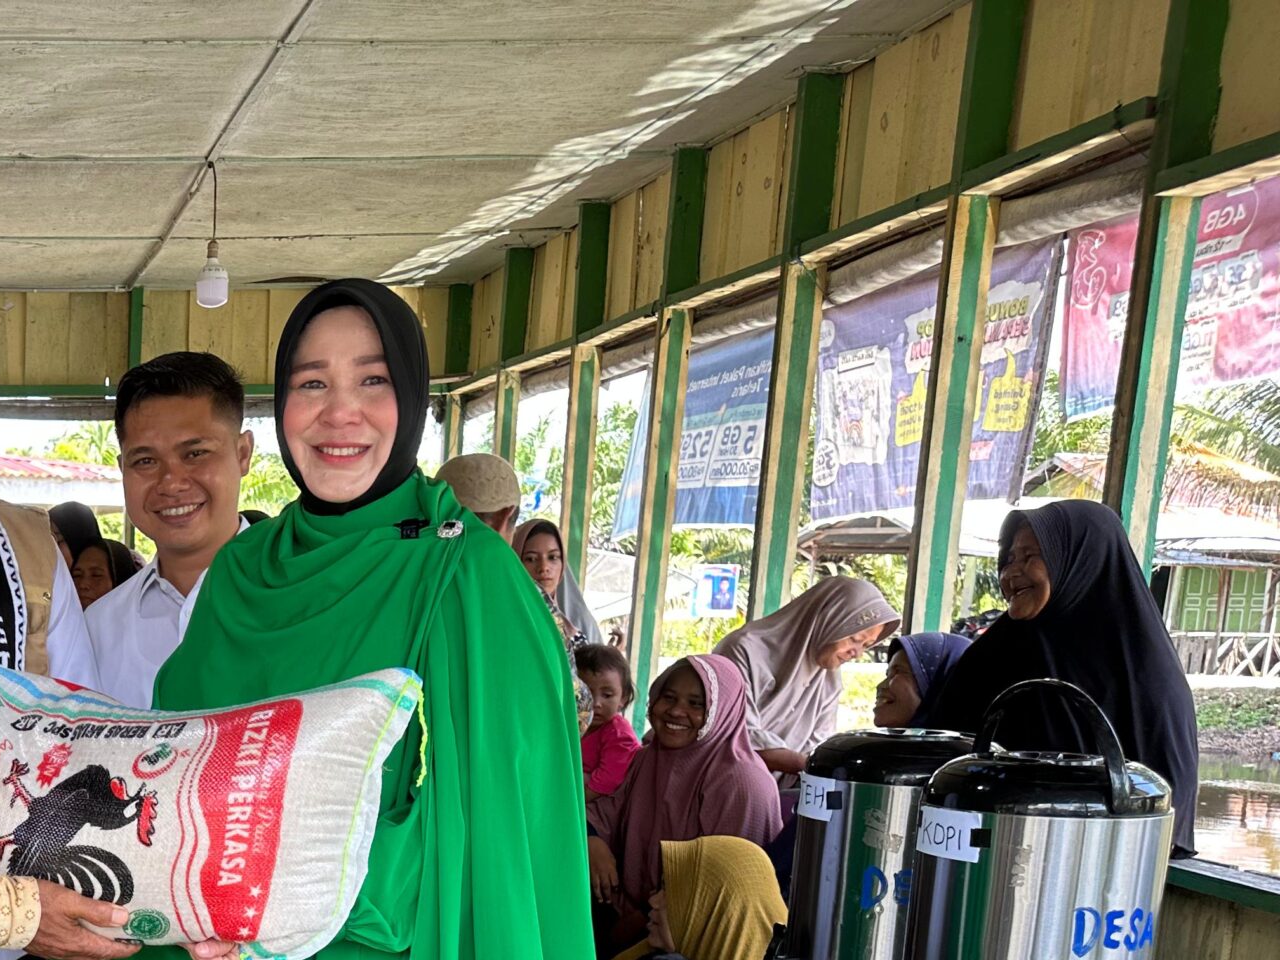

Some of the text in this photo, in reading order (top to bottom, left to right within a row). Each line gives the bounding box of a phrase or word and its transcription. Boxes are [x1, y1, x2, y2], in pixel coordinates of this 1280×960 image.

[43, 721, 71, 738] SPC
[104, 724, 151, 738] BERAS
[216, 708, 275, 887] RIZKI PERKASA
[922, 821, 962, 851] KOPI
[860, 865, 913, 910] DE
[1072, 906, 1153, 958] DESA
